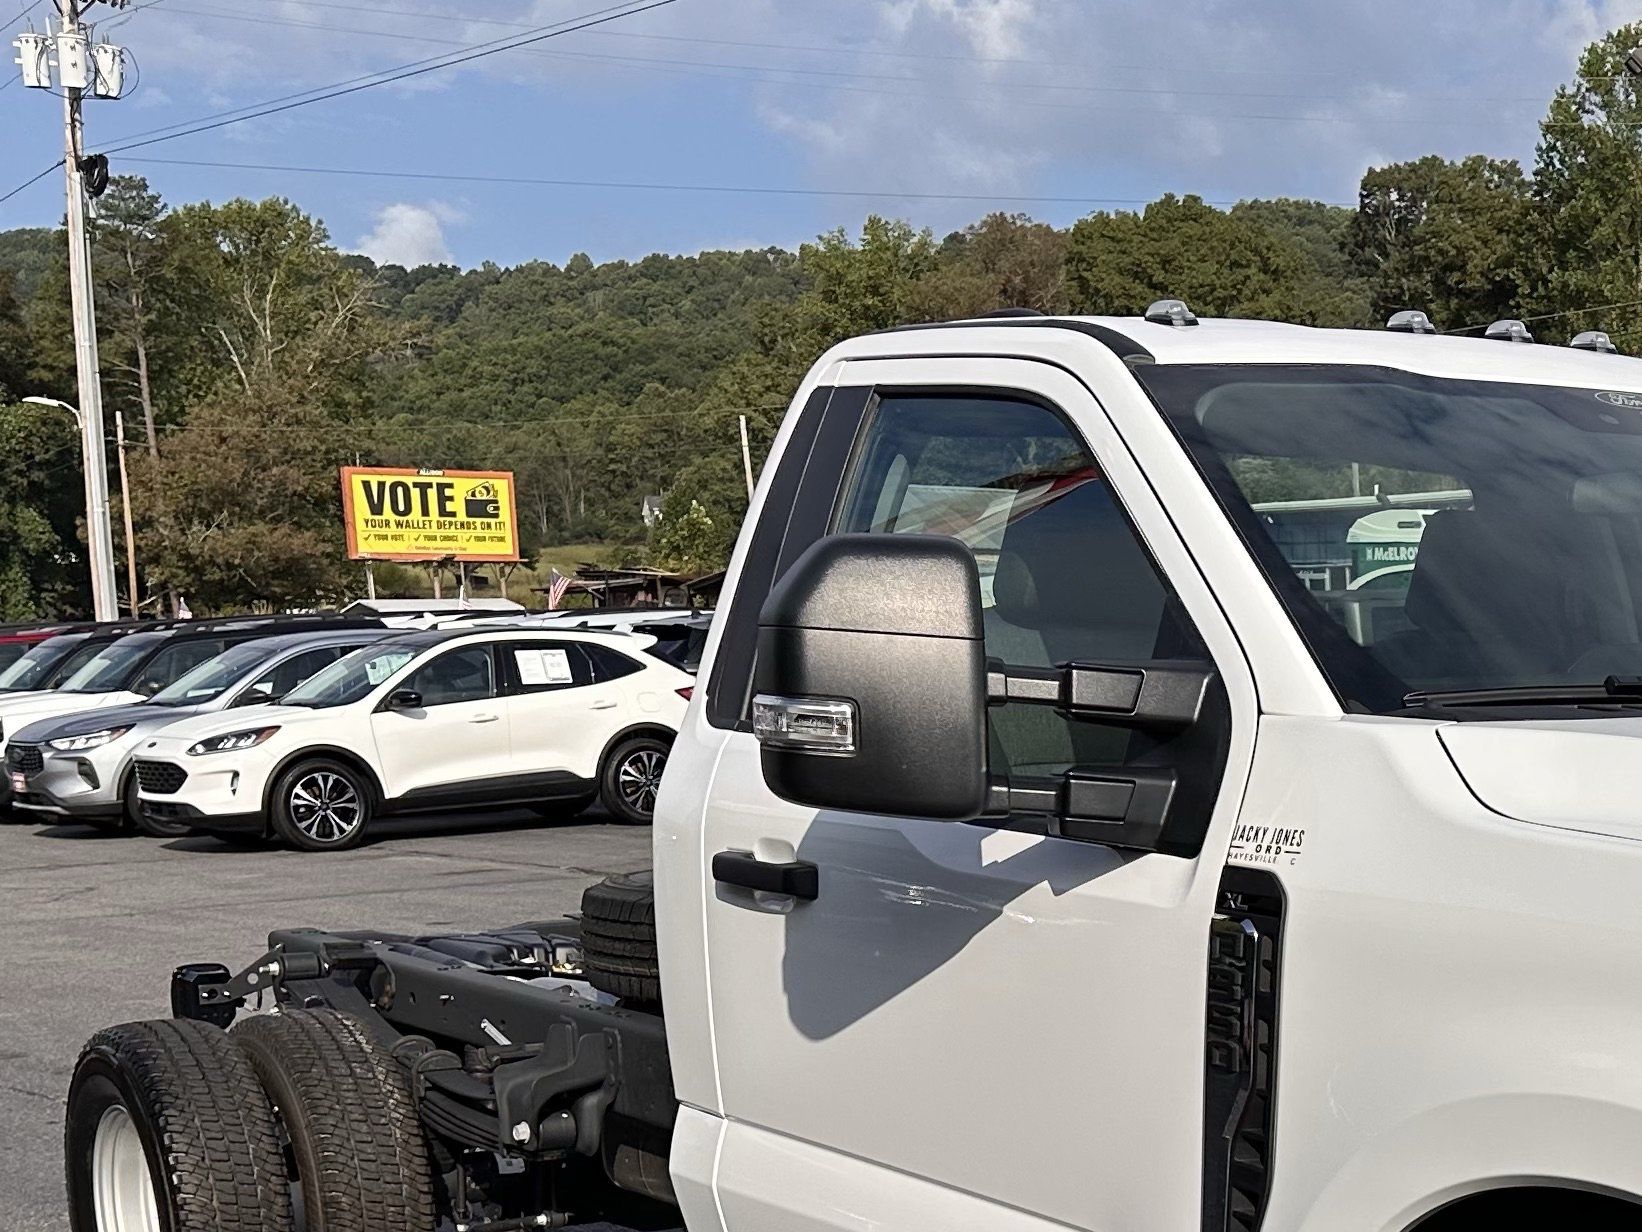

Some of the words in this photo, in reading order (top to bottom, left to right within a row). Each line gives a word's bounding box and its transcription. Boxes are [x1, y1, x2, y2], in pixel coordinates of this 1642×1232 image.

[361, 480, 457, 518] VOTE
[363, 518, 391, 529] YOUR
[394, 519, 433, 530] WALLET
[436, 520, 477, 531] DEPENDS
[480, 521, 492, 531] ON
[1232, 825, 1269, 843] JACKY
[1269, 828, 1305, 847] JONES
[1223, 892, 1248, 911] XL
